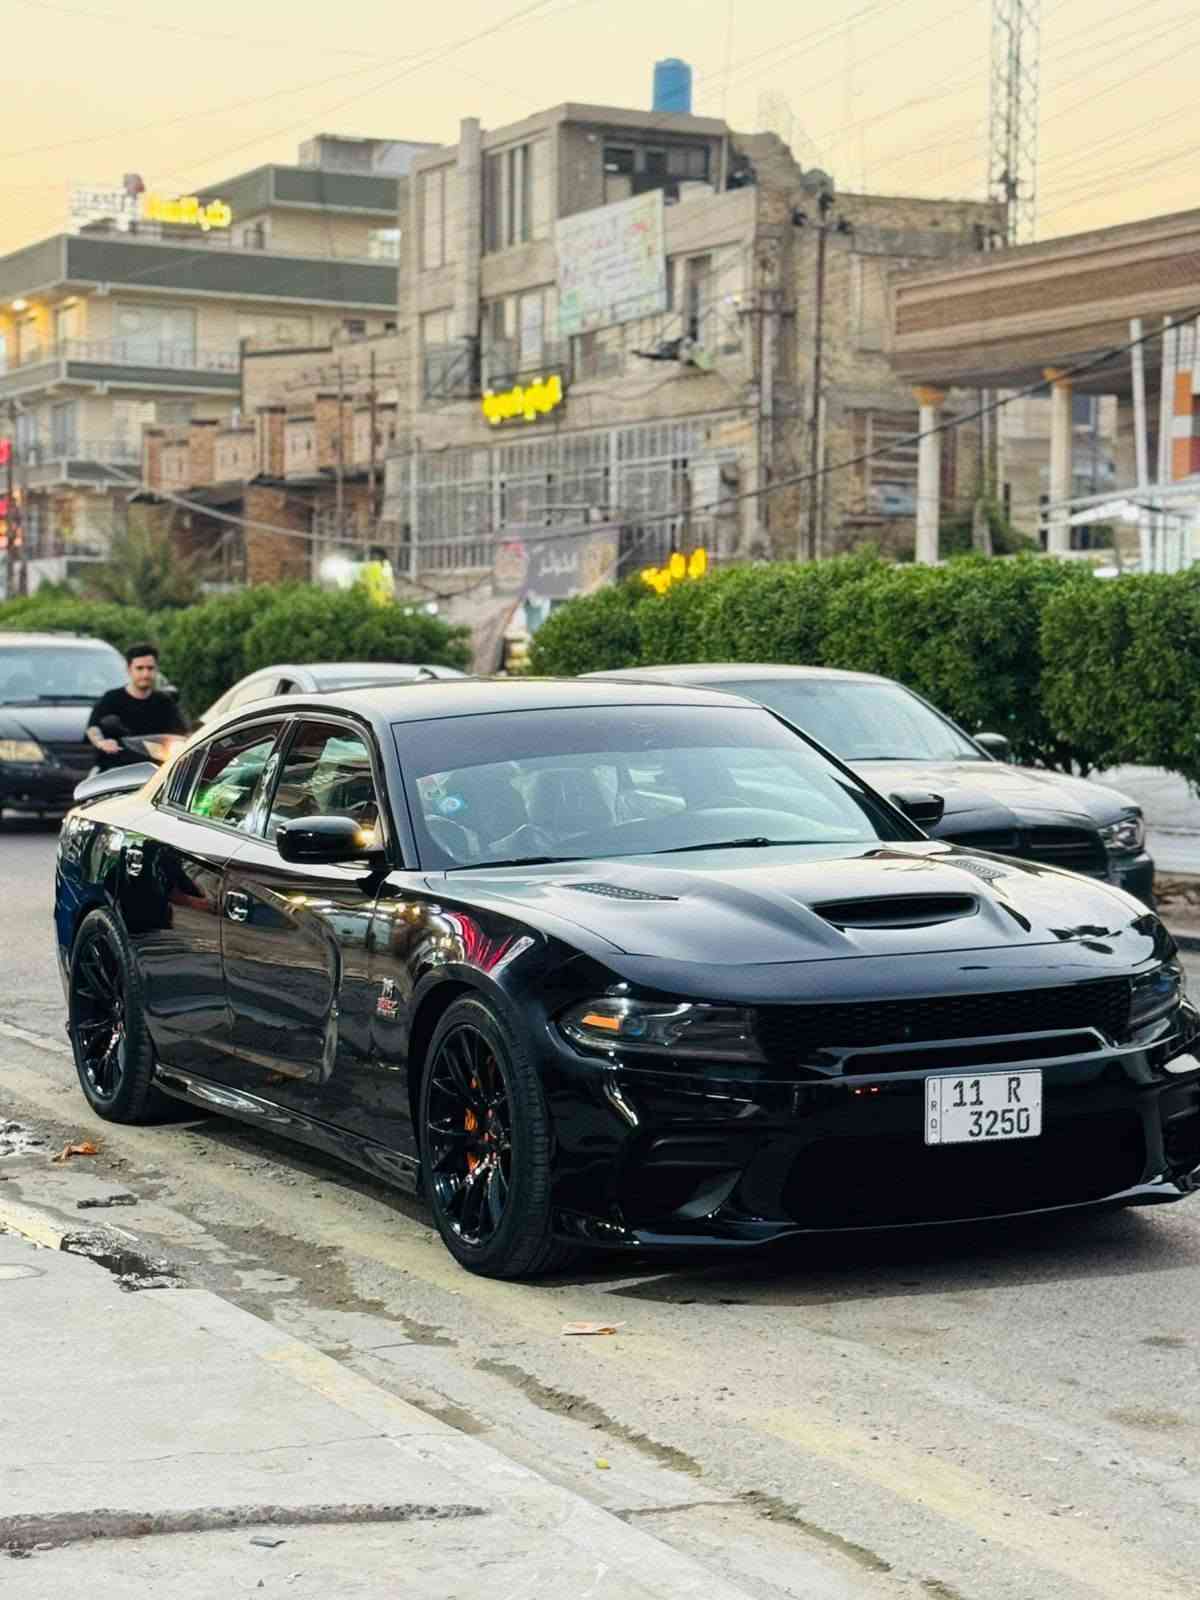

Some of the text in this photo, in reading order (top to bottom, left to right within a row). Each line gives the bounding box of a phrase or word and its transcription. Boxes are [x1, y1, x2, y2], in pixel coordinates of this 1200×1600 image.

[952, 1076, 1022, 1107] 11 R
[968, 1107, 1030, 1137] 3250
